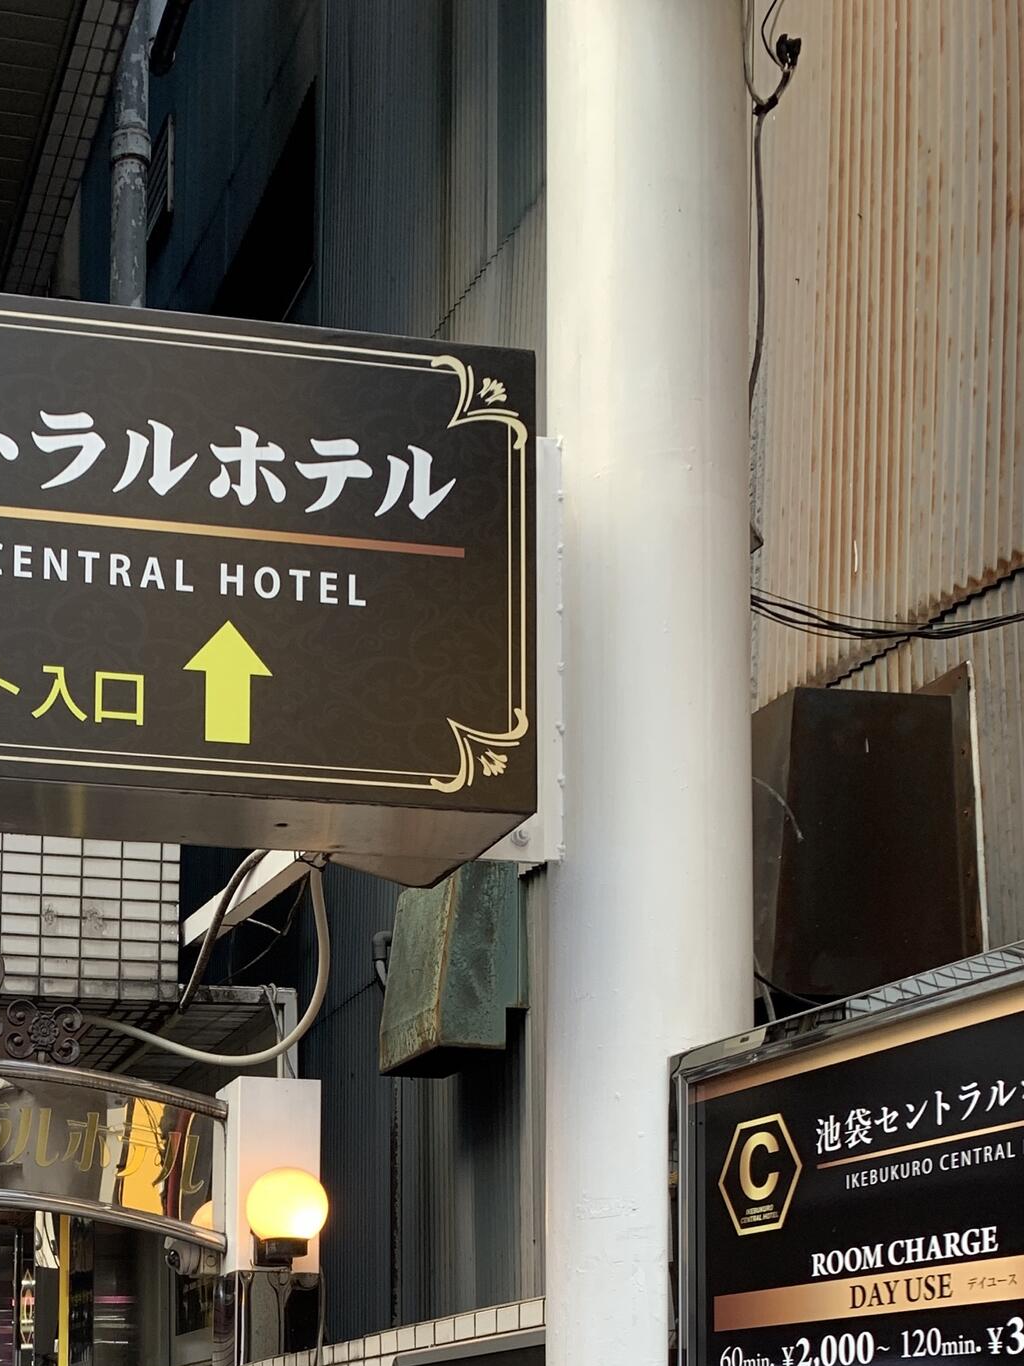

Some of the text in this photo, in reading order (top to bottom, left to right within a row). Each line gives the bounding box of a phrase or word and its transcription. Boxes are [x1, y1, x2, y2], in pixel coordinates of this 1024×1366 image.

[220, 562, 367, 607] HOTEL
[815, 1079, 1024, 1156] 池袋セントラル
[739, 1131, 780, 1201] C
[845, 1141, 1016, 1190] IKEBUKURO CENTRAL
[811, 1226, 999, 1277] ROOM CHARGE
[849, 1273, 954, 1310] DAY USE
[900, 1327, 982, 1360] 120min.
